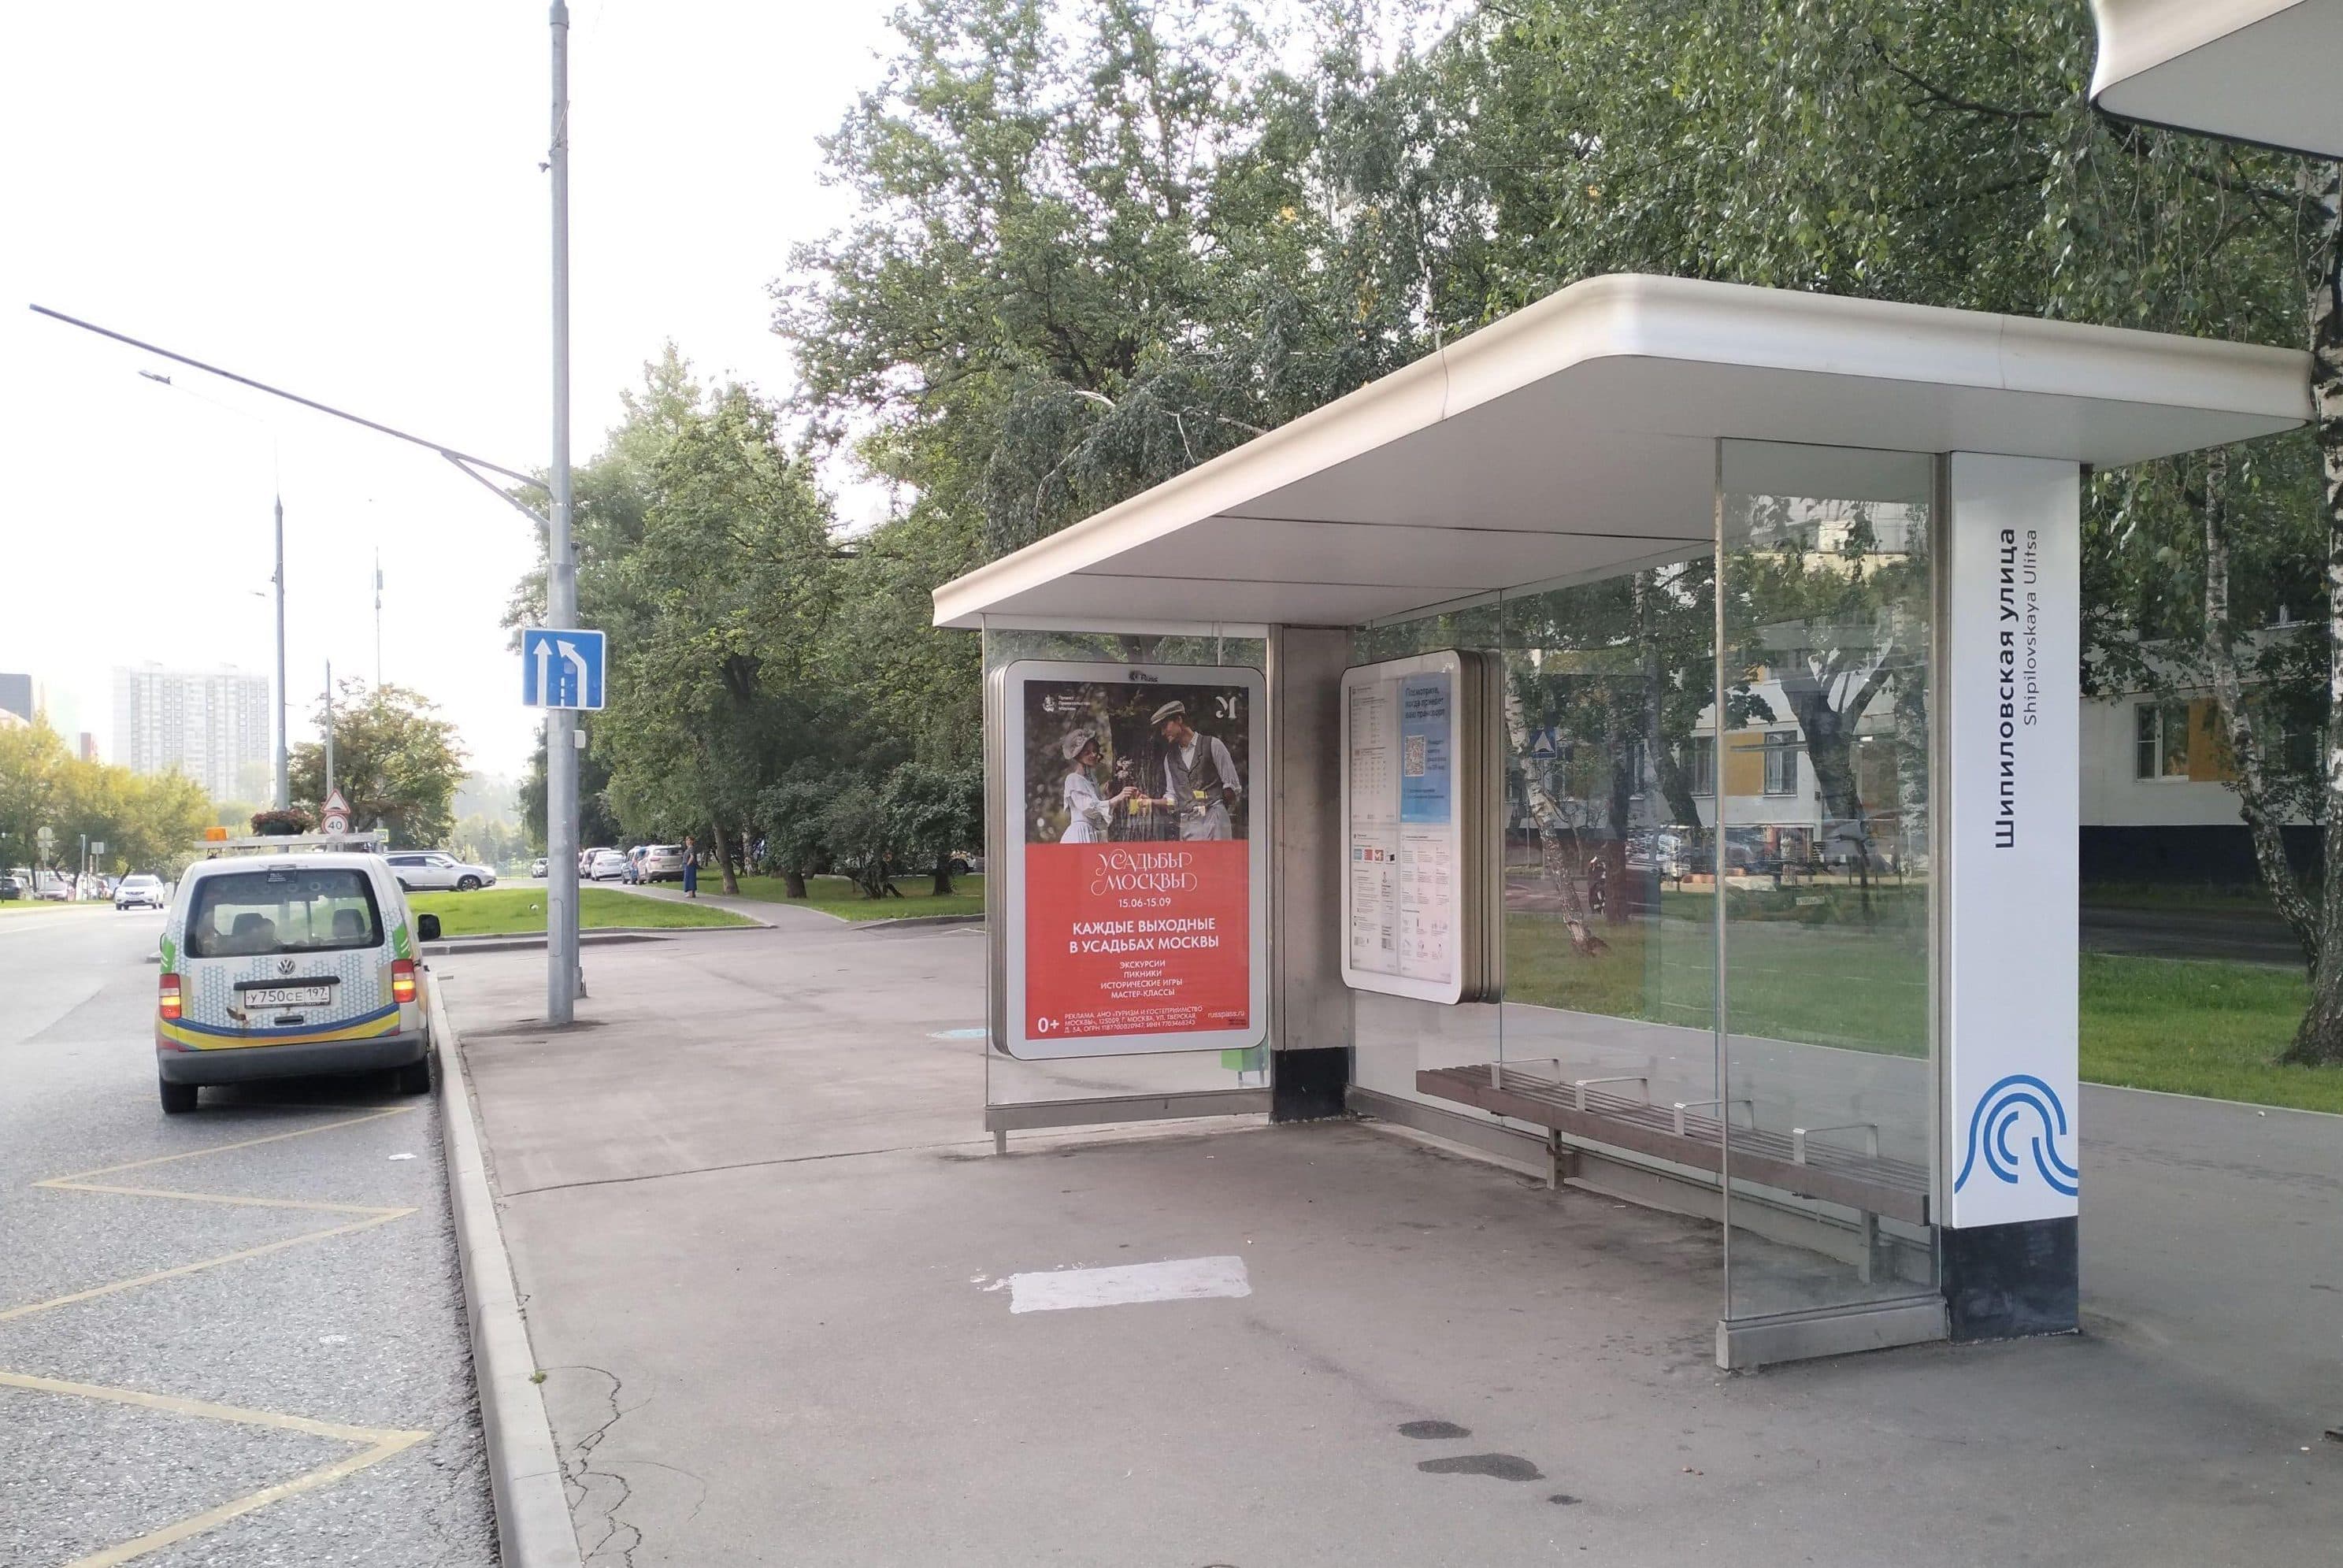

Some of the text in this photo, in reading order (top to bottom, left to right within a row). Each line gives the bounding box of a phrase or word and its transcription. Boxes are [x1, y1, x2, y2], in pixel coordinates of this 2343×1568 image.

[2022, 529, 2040, 726] Shipilovskaya Ulitsa
[1996, 528, 2019, 849] Шипиловская улица
[327, 821, 343, 830] 40
[1096, 849, 1192, 876] УСАДЬБЫ
[1091, 873, 1197, 895] МОСКВЫ
[1118, 898, 1171, 907] 15.06-15.09
[1073, 917, 1216, 936] КАЖДЫЕ ВЫХОДНЫЕ
[1070, 936, 1219, 954] В УСАДЬБАХ МОСКВЫ
[1119, 959, 1166, 969] ЭКСКУРСИИ
[1100, 978, 1183, 989] ИСТОРИЧЕСКИЕ ИГРЫ
[306, 988, 325, 997] 197
[1110, 988, 1175, 999] МАСТЕР-КЛАССЫ
[1037, 1017, 1059, 1032] 0+
